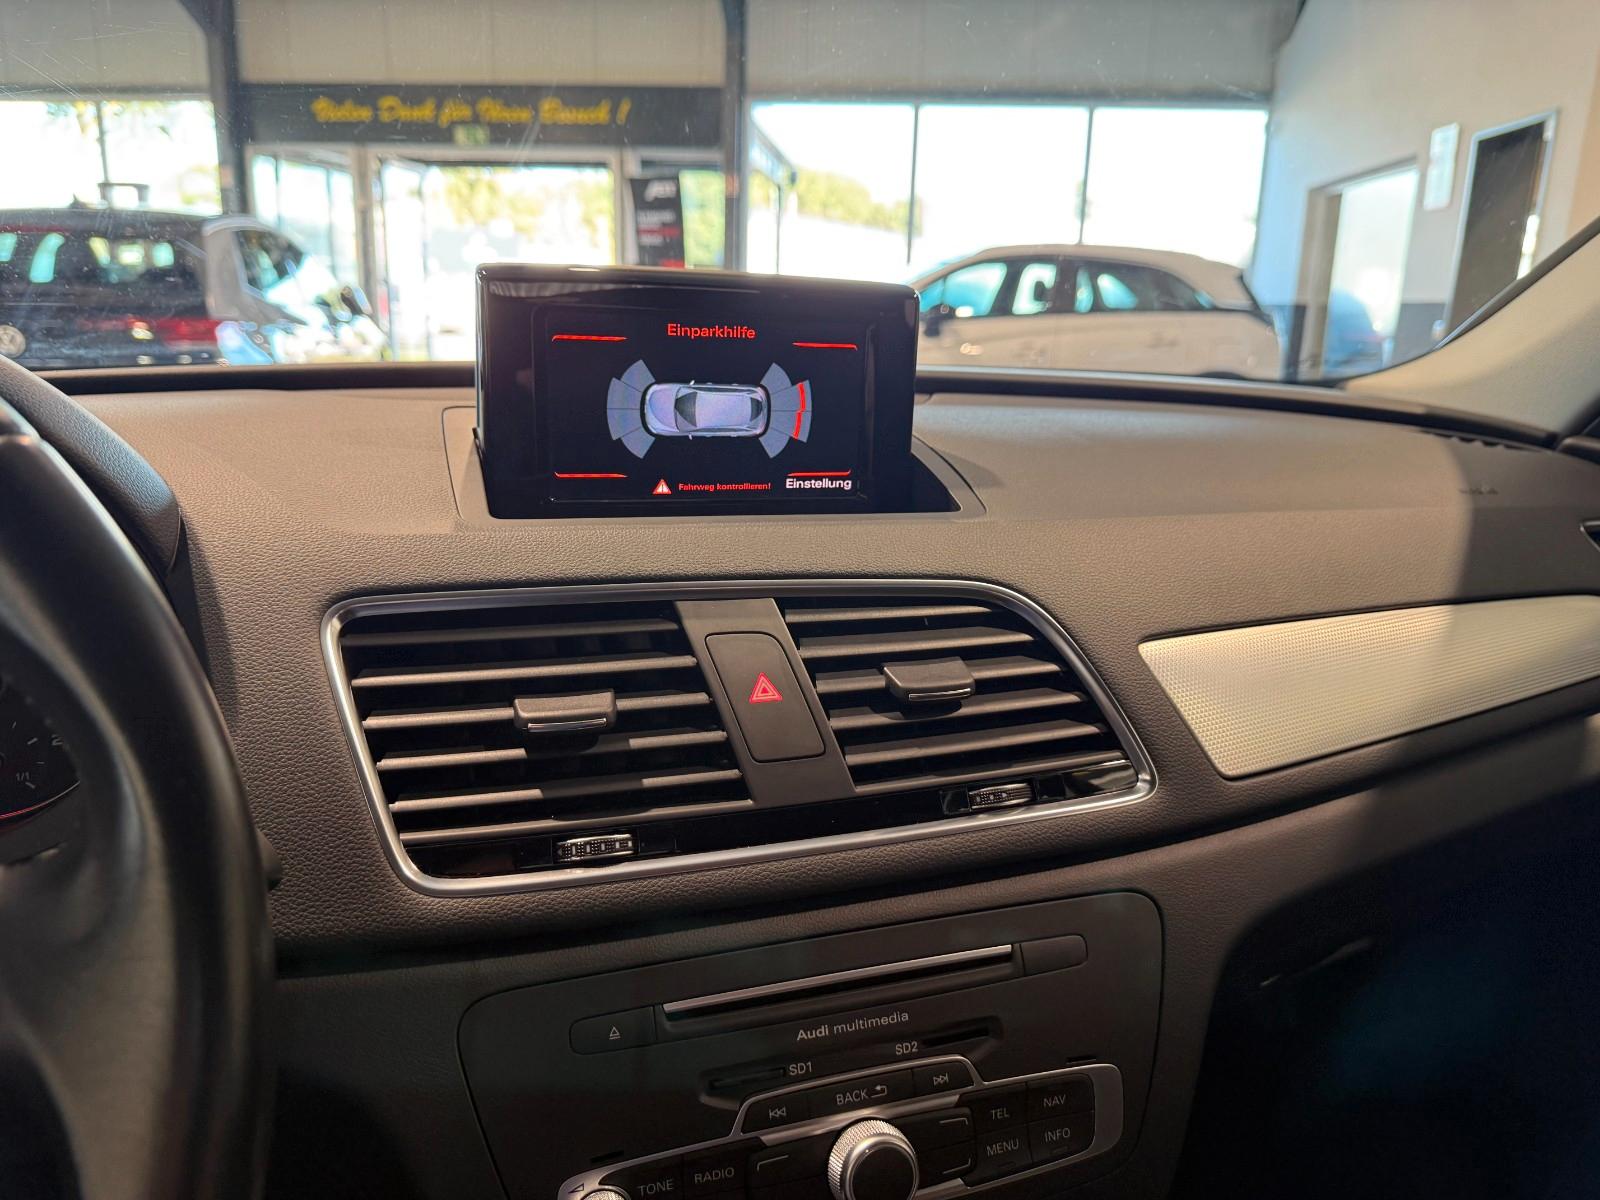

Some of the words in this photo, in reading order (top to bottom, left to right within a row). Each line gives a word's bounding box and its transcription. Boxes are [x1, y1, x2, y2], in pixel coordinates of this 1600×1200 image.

[667, 323, 756, 340] Einparkhilfe
[678, 483, 715, 492] Fahrweg
[716, 482, 772, 492] kontrollieren!
[785, 478, 852, 491] Einstellung
[796, 1024, 829, 1041] Audi
[833, 1011, 910, 1035] multimedia
[895, 1041, 919, 1056] SD2
[789, 1061, 813, 1076] SD1
[836, 1089, 869, 1105] BACK
[1043, 1094, 1066, 1108] NAV
[990, 1107, 1010, 1120] TEL
[1044, 1127, 1071, 1143] INFO
[986, 1138, 1020, 1157] MENU
[694, 1167, 735, 1185] RADIO
[638, 1179, 674, 1197] TONE
